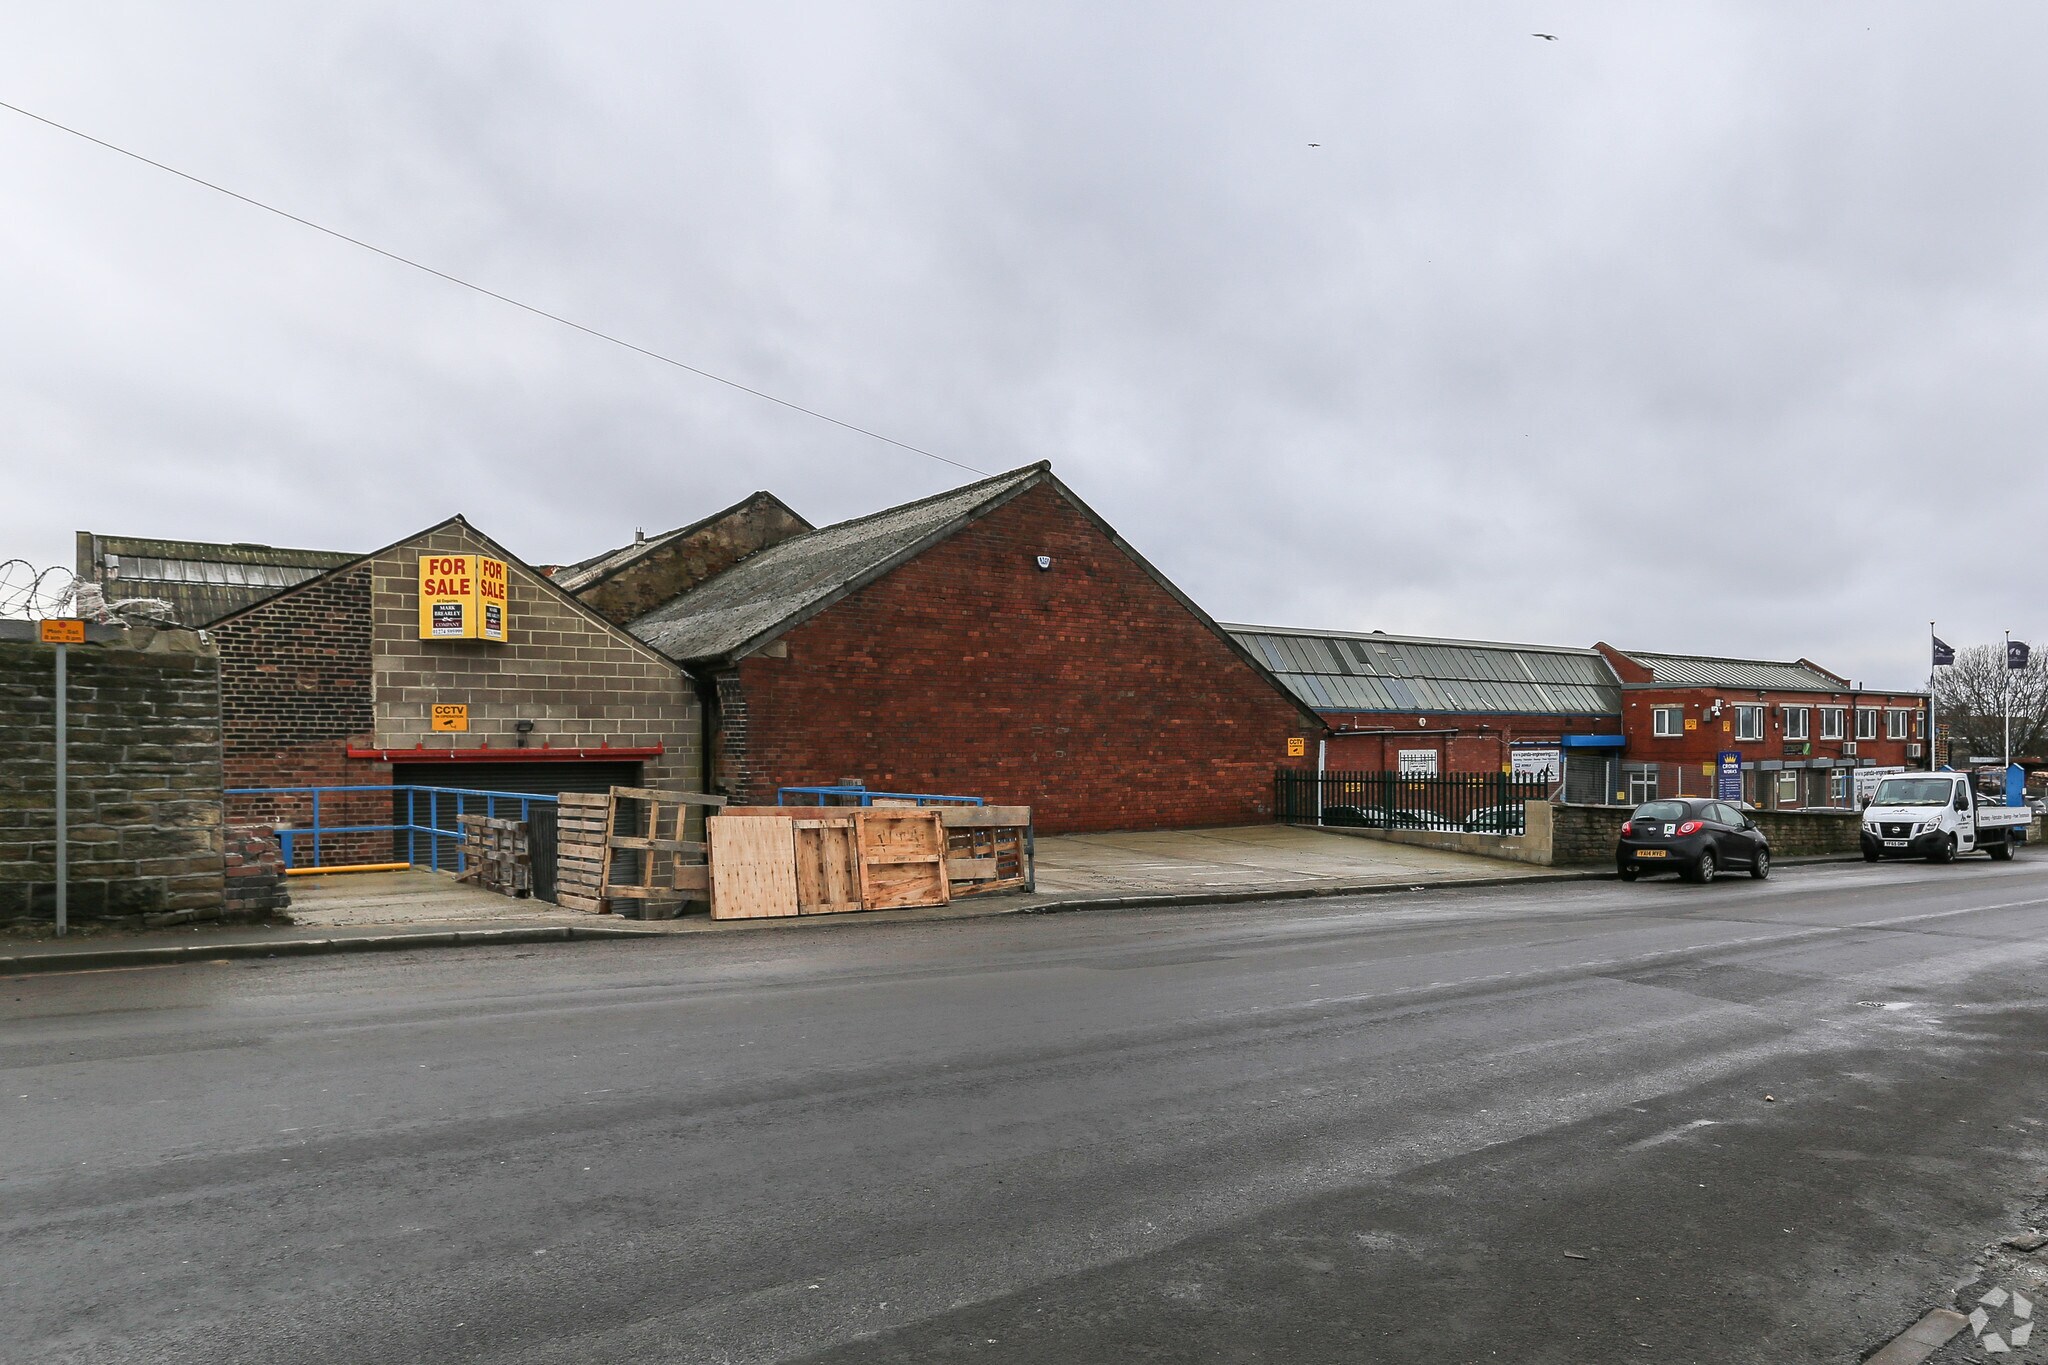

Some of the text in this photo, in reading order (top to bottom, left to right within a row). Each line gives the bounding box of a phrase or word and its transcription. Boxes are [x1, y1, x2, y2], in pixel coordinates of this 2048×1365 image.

[429, 558, 466, 576] FOR
[483, 559, 502, 580] FOR
[424, 578, 471, 596] SALE
[480, 579, 505, 600] SALE
[435, 706, 464, 714] CCTV
